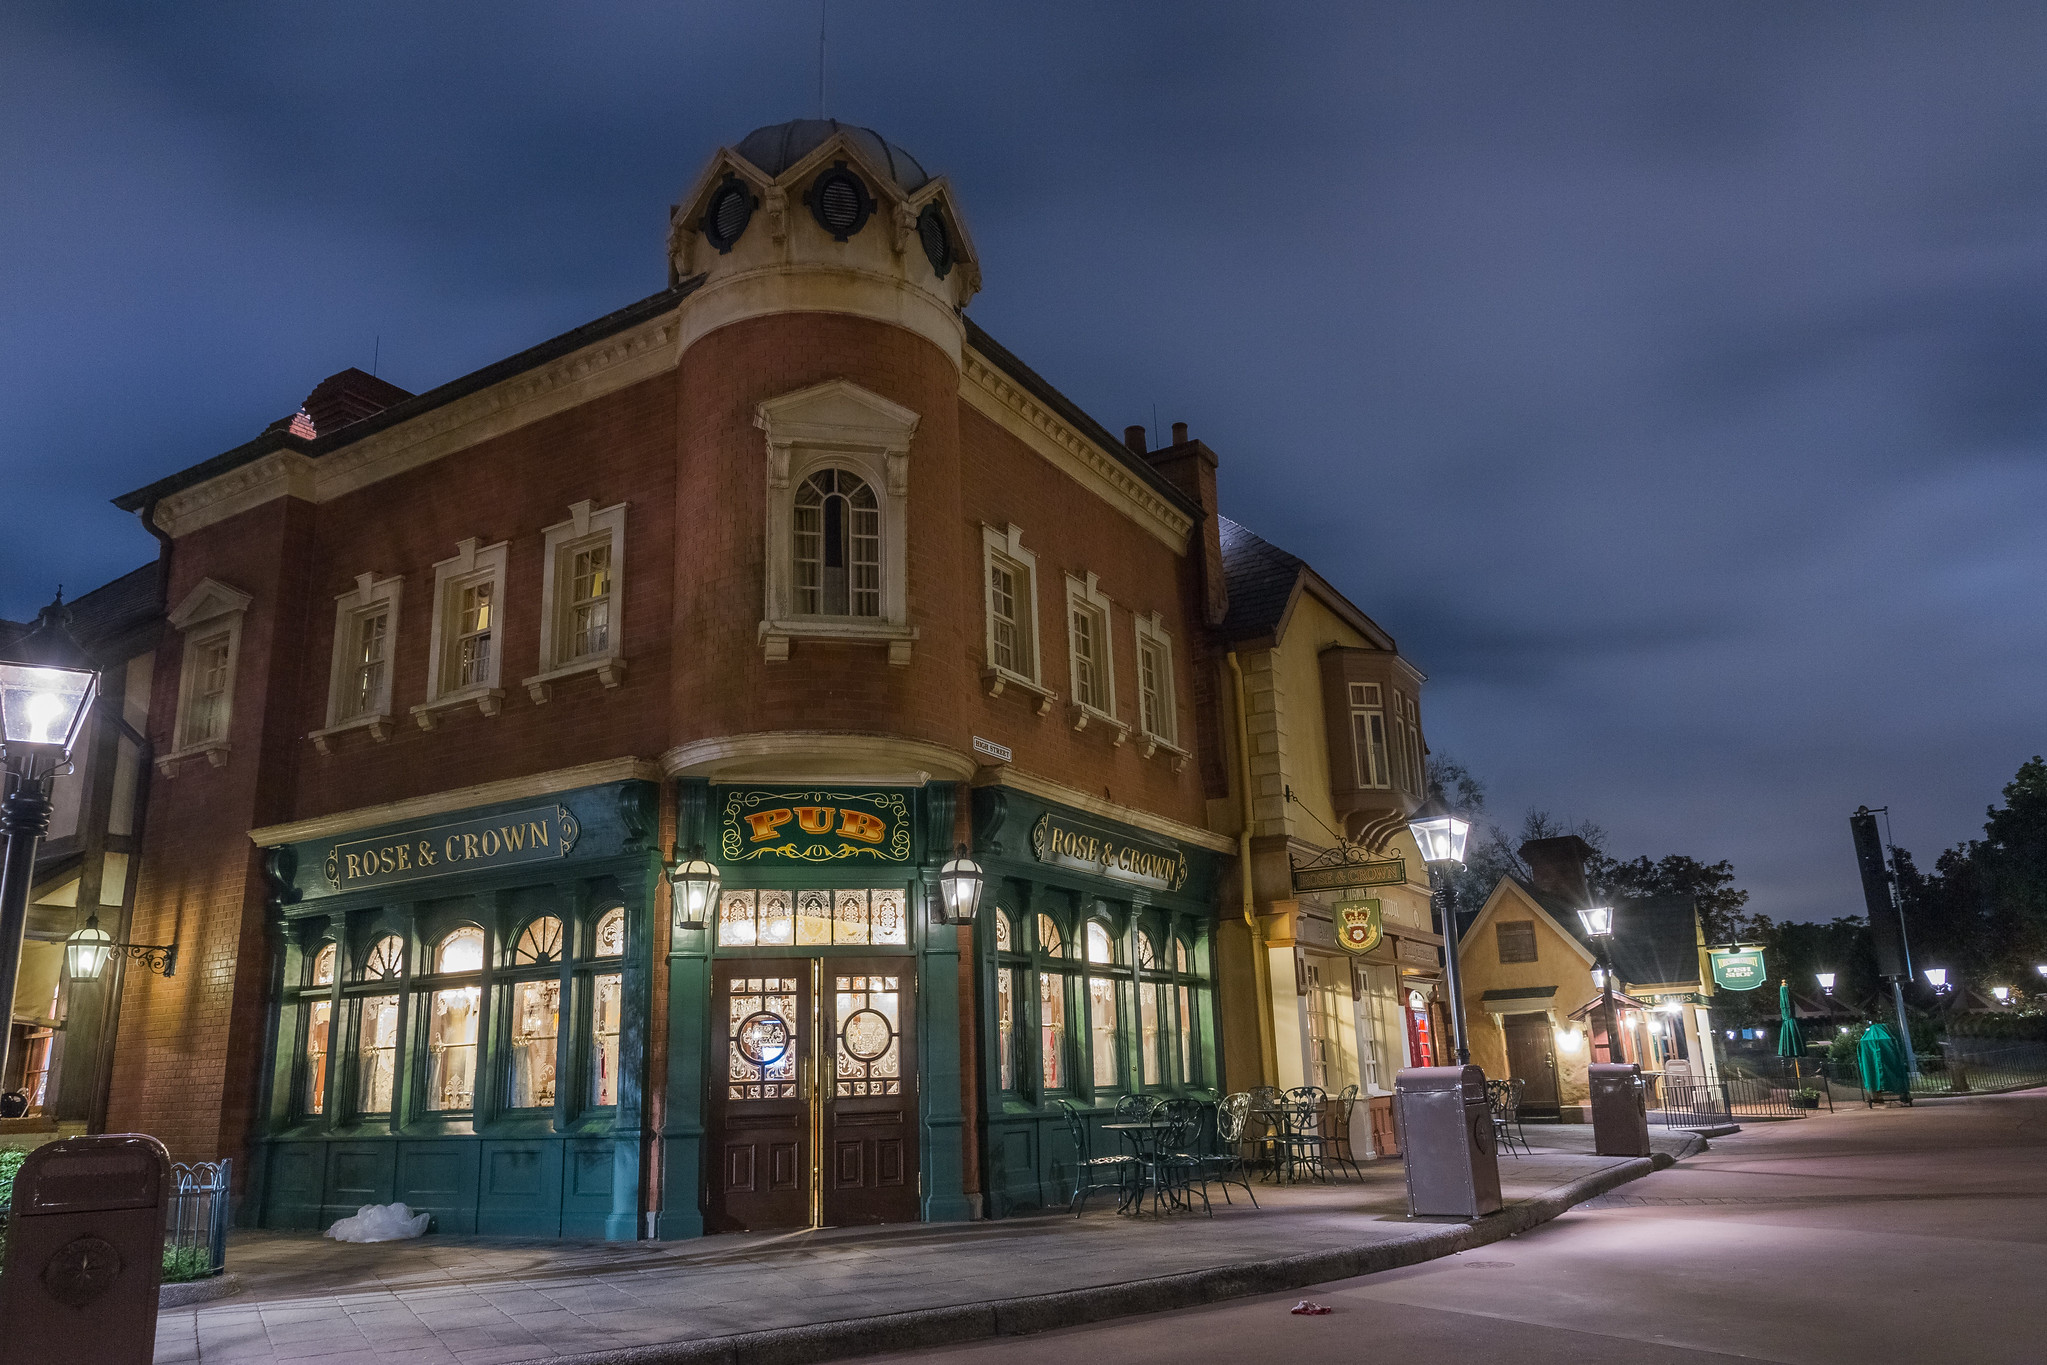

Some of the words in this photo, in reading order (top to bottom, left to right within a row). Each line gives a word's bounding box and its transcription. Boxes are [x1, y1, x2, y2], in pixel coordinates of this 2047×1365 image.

[975, 740, 989, 750] HIGH
[990, 746, 1010, 758] STREET
[744, 806, 887, 844] PUB
[345, 843, 412, 879] ROSE
[418, 840, 439, 867] &
[445, 819, 549, 862] CROWN
[1048, 826, 1100, 862] ROSE
[1100, 842, 1114, 867] &
[1117, 846, 1176, 881] CROWN
[1300, 871, 1333, 887] ROSE
[1335, 870, 1347, 884] &
[1347, 865, 1398, 882] CROWN
[1663, 994, 1692, 1002] CHIPS
